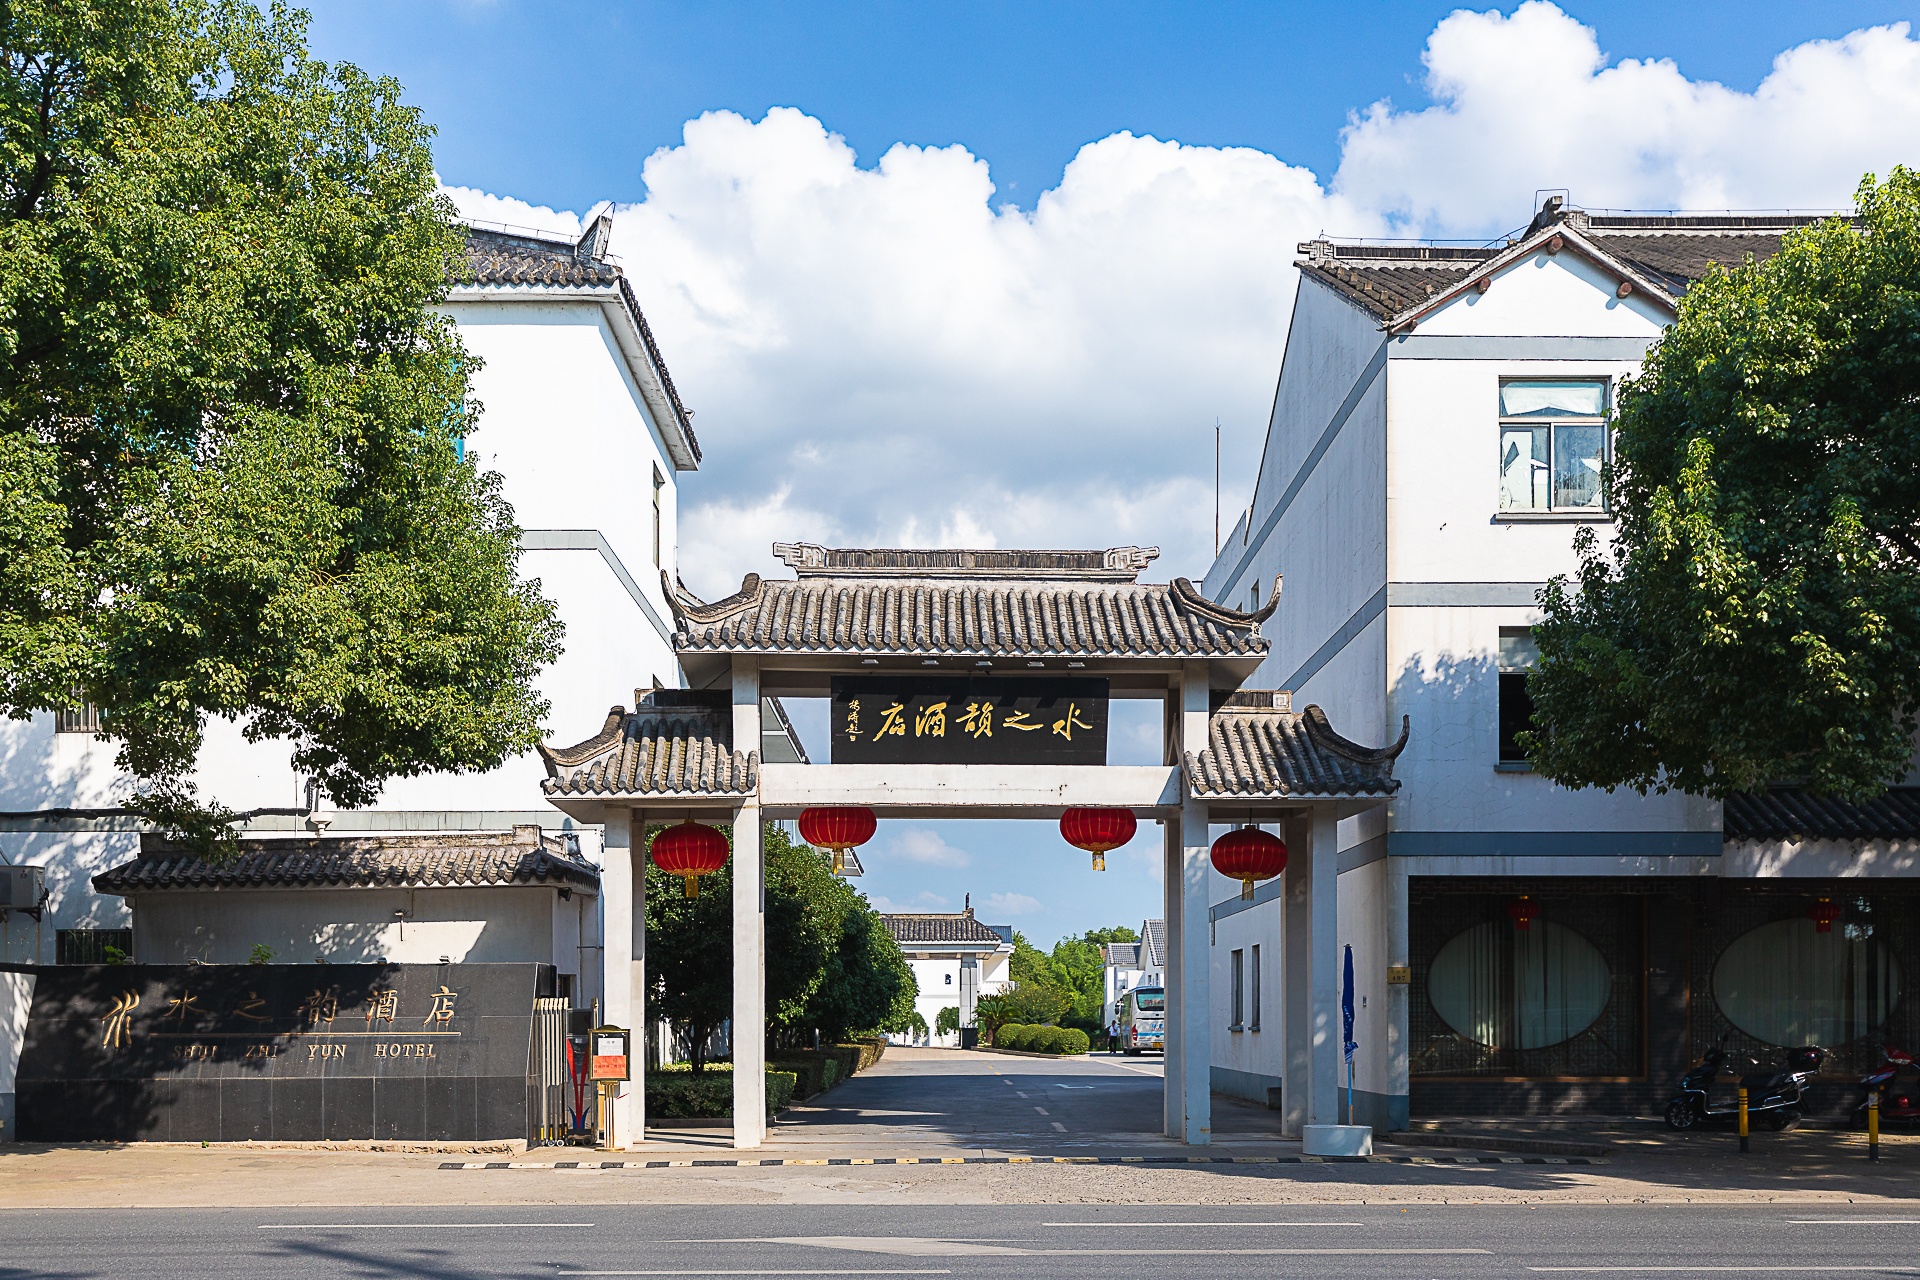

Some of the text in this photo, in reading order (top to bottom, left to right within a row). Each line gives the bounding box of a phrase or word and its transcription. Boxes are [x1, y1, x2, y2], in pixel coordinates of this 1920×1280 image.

[162, 985, 458, 1026] 水之韵酒店
[173, 1042, 437, 1060] SHUI ZHI YUN HOTEL
